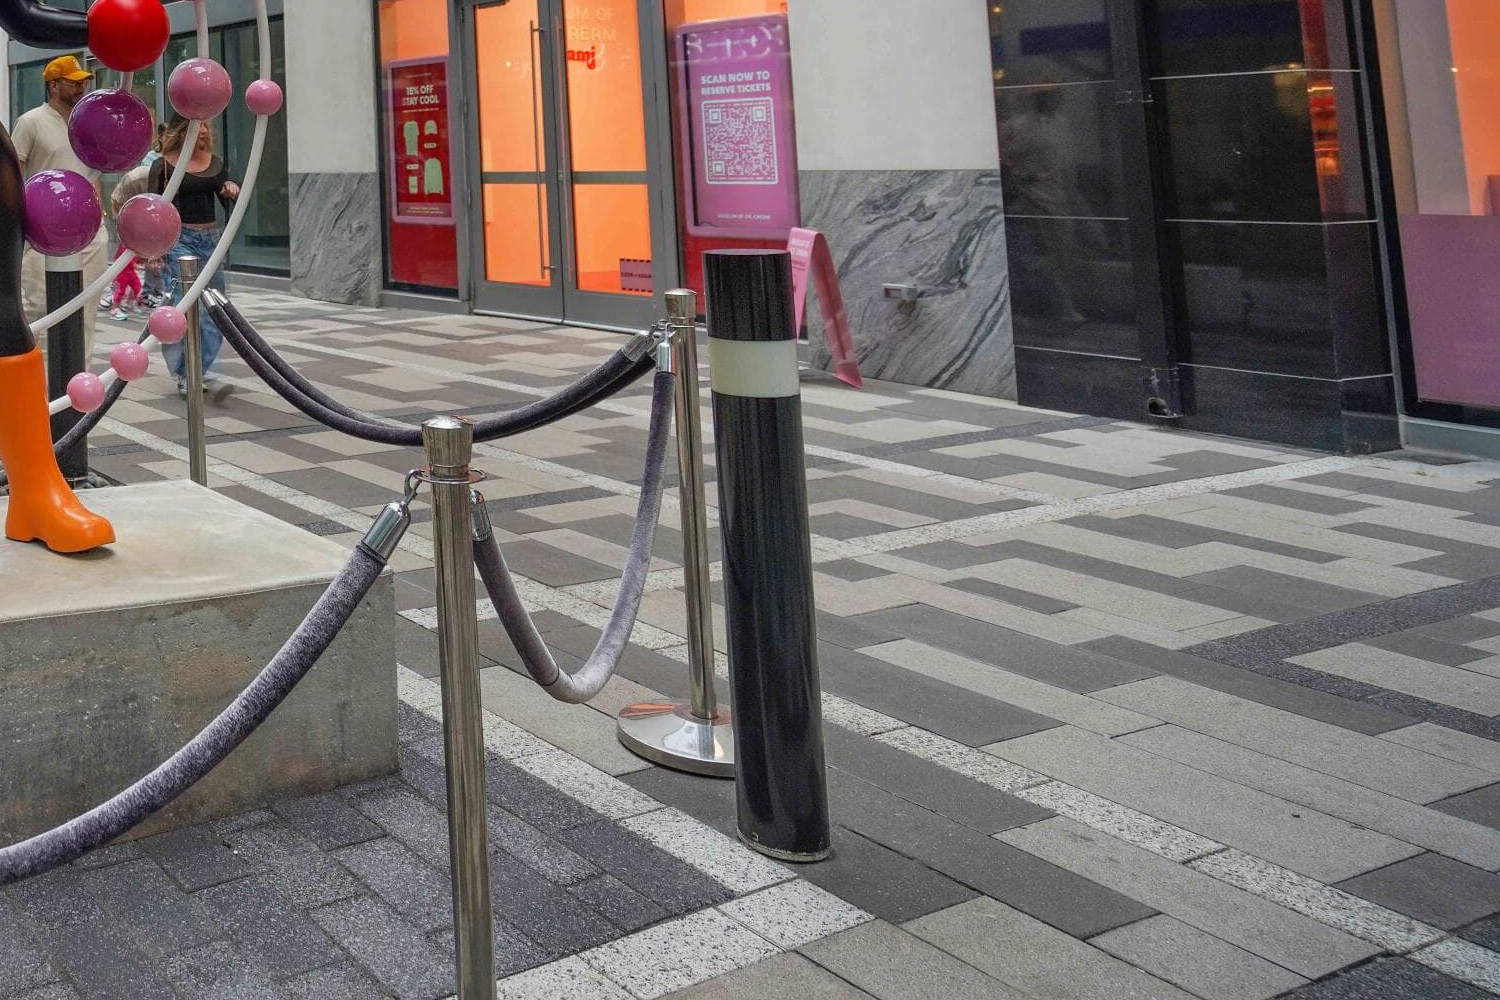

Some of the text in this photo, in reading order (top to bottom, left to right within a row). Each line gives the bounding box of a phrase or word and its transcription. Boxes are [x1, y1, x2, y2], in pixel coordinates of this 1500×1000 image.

[569, 26, 617, 41] REAM
[700, 70, 770, 85] SCAN NOW TO
[420, 84, 434, 95] OFF
[701, 83, 772, 96] RESERVE TICKETS
[419, 94, 440, 105] COOL
